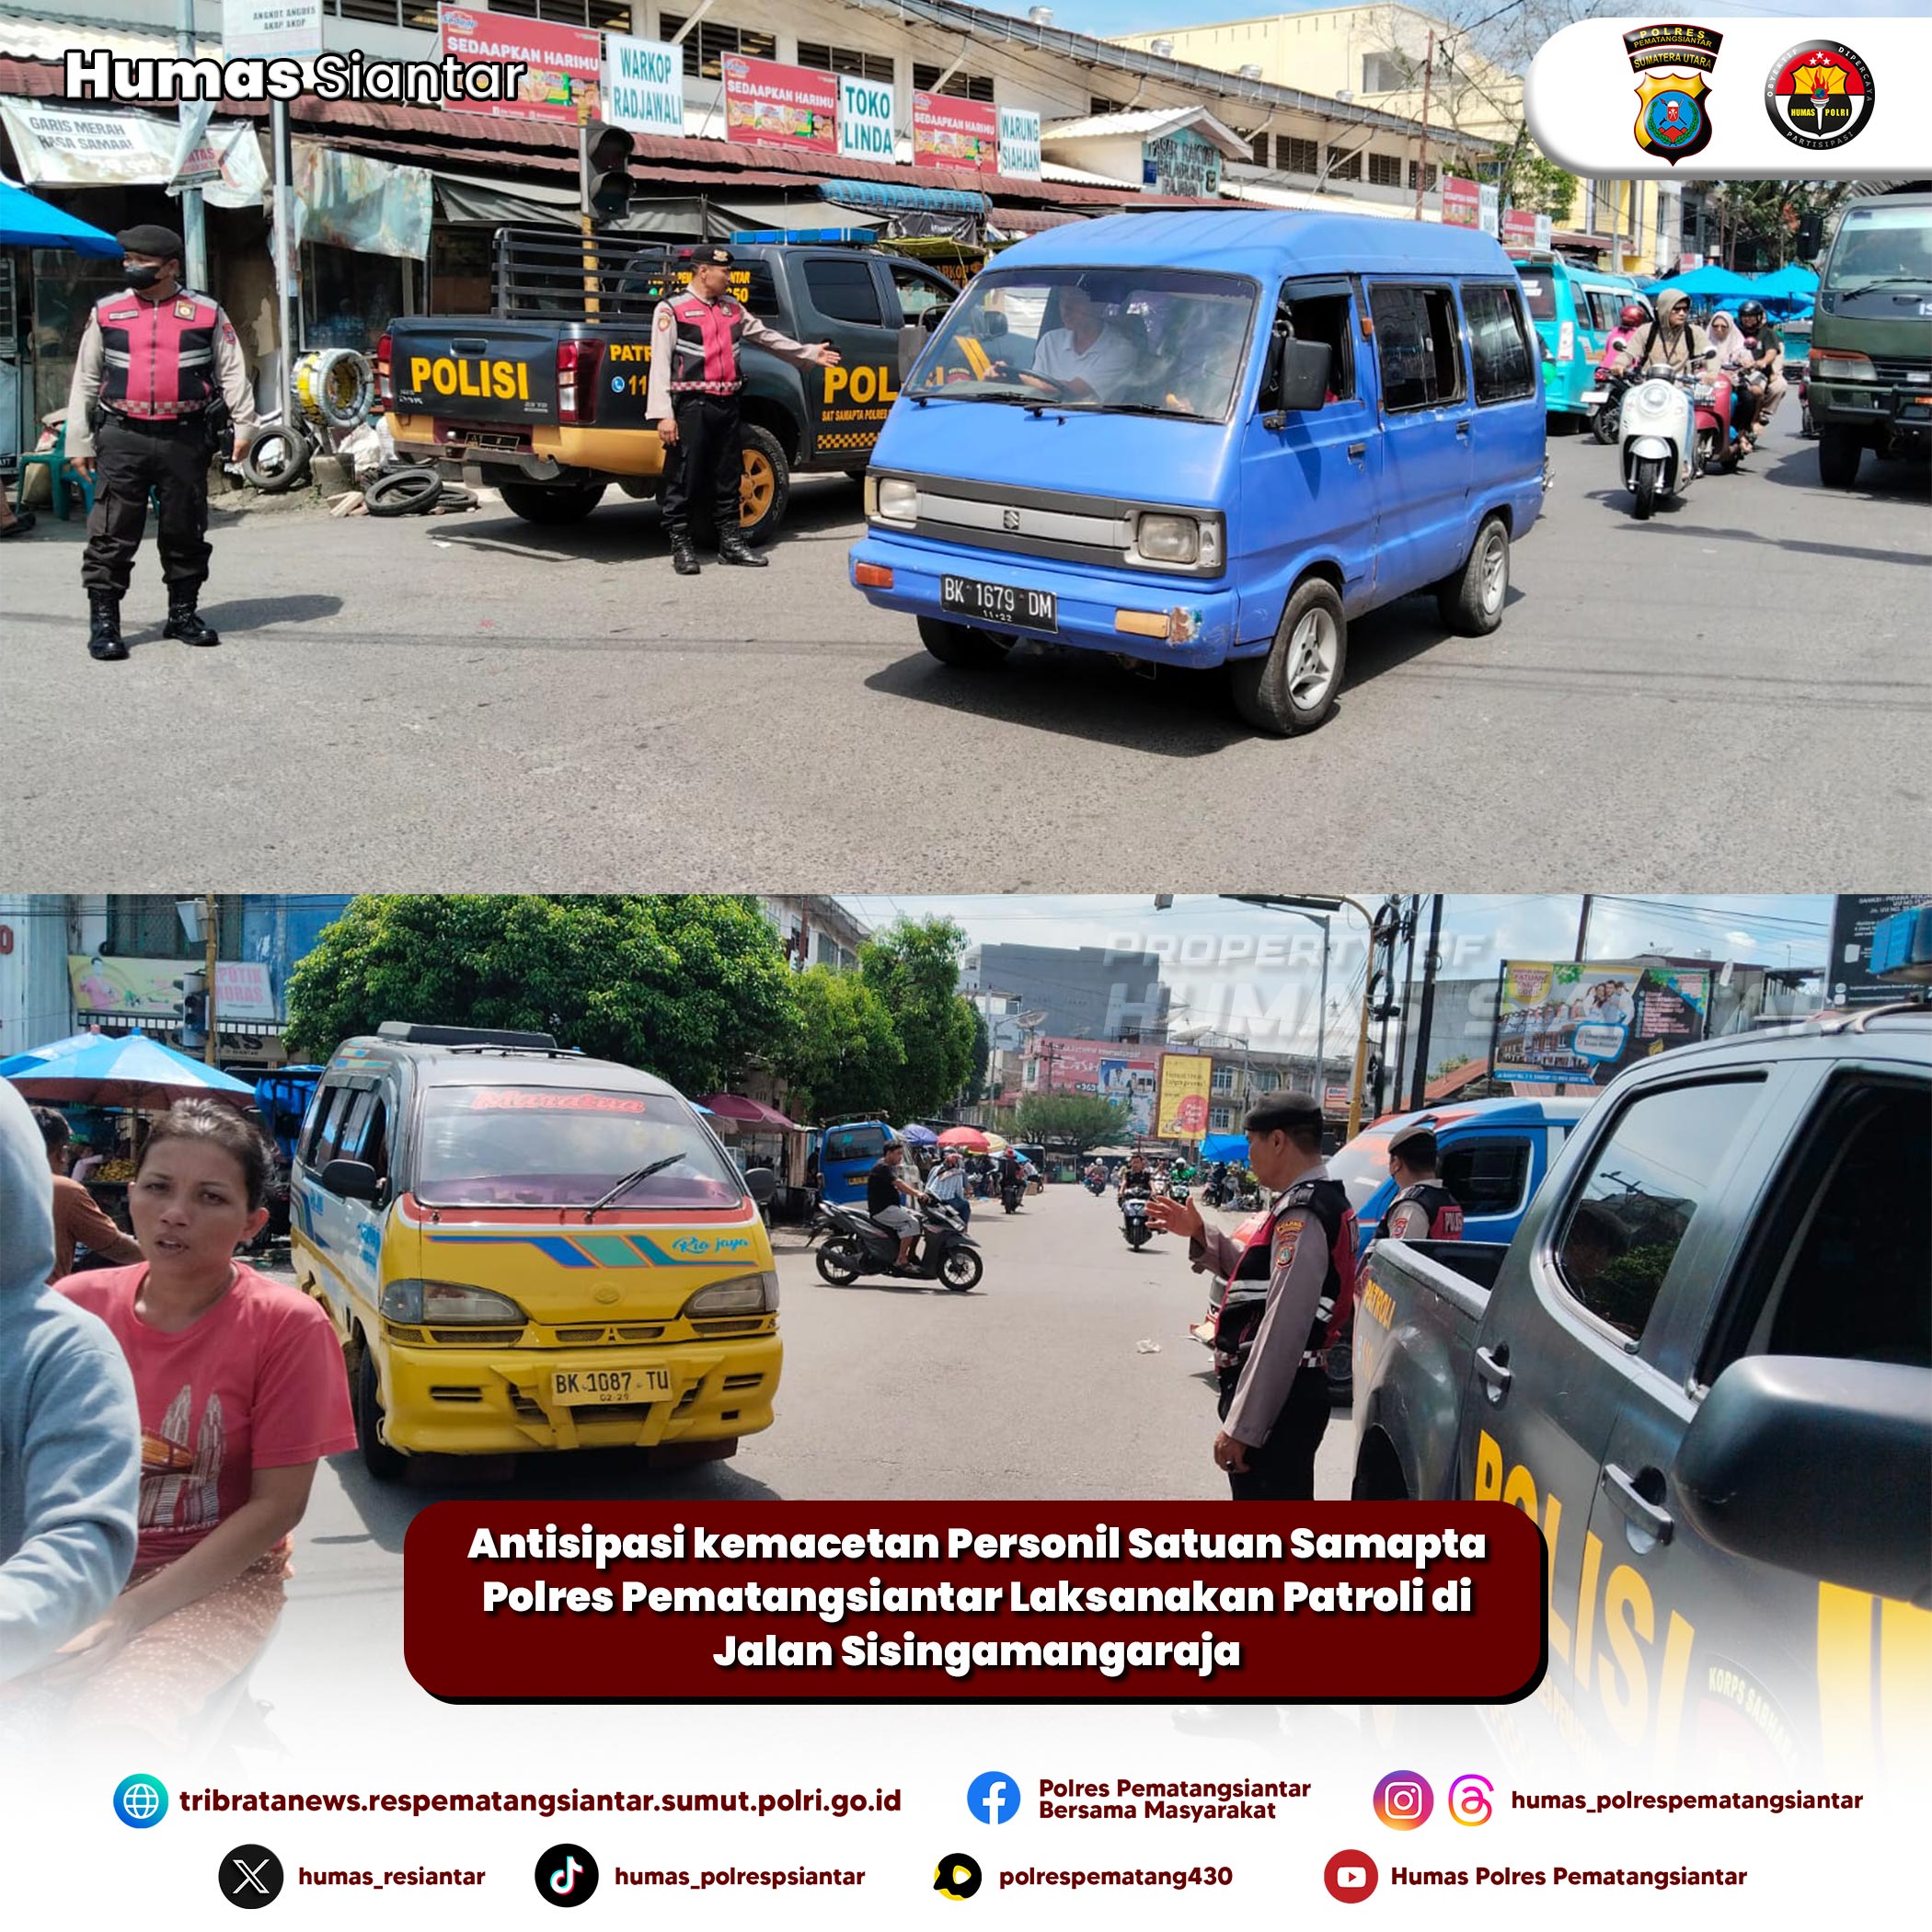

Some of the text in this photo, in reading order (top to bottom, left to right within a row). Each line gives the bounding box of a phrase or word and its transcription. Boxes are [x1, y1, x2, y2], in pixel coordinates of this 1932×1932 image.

[447, 37, 600, 71] SEDAAPKAN HARIMU
[620, 48, 672, 84] WARKOP
[614, 86, 683, 125] RADJAWALI
[728, 80, 834, 109] SEDAAPKAN HARIMU
[845, 86, 890, 119] TOKO
[29, 117, 126, 136] GARIS MERAH
[845, 122, 893, 155] LINDA
[1002, 114, 1039, 141] WARUNG
[1003, 146, 1040, 172] SIAHAAN
[610, 344, 652, 362] PATR
[410, 357, 530, 400] POLISI
[945, 578, 1052, 618] BK 1679 DM
[1363, 1279, 1397, 1331] PATROLI
[556, 1371, 669, 1394] BK 1087 TU
